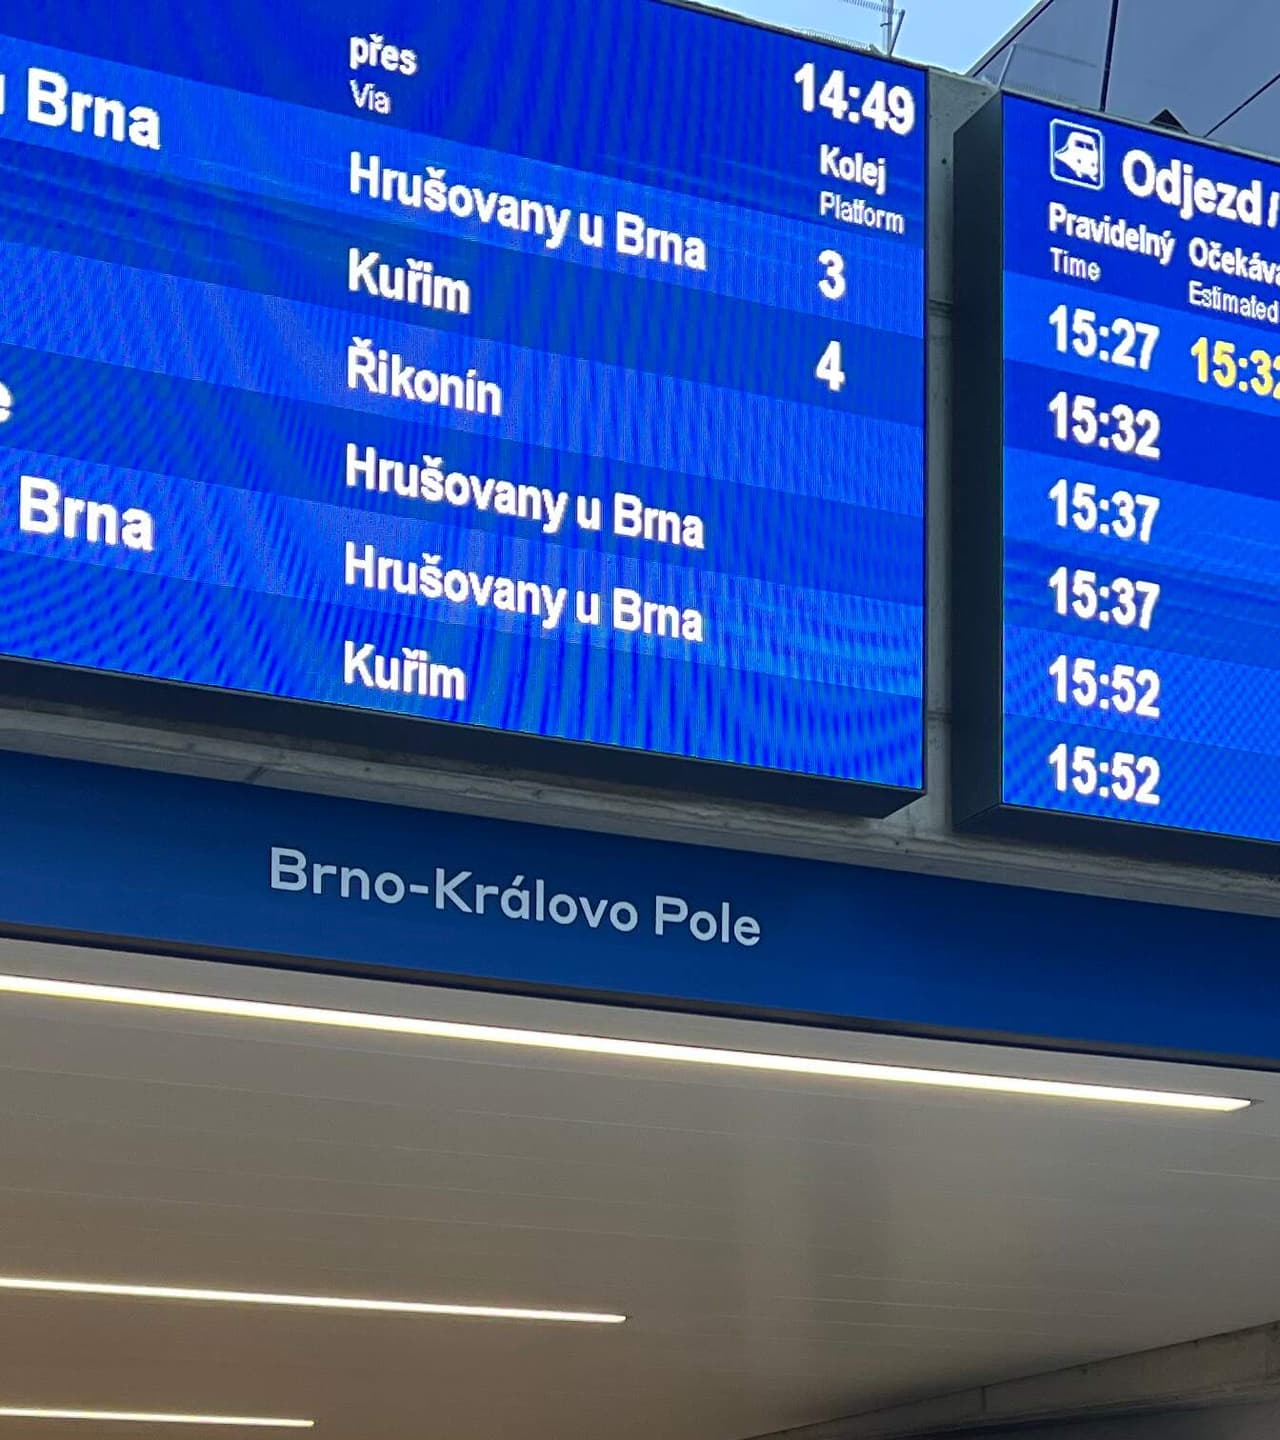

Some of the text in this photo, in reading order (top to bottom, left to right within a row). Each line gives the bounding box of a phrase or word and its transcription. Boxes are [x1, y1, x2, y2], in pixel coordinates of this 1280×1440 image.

[349, 33, 417, 76] přes
[27, 67, 161, 150] Brna
[793, 61, 916, 136] 14:49
[820, 144, 887, 194] Kolej
[1121, 148, 1263, 227] Odjezd
[349, 151, 707, 271] Hrušovany u Brna
[820, 190, 905, 234] Platform
[1049, 202, 1177, 267] Pravidelný
[348, 247, 470, 314] Kuřim
[818, 249, 846, 300] 3
[1050, 247, 1101, 281] Time
[1189, 280, 1280, 324] Estimated
[815, 340, 846, 391] 4
[1049, 304, 1160, 370] 15:27
[347, 336, 502, 416] Řikonín
[1048, 391, 1160, 459] 15:32
[19, 475, 154, 552] Brna
[346, 443, 705, 549] Hrušovany u Brna
[1049, 479, 1160, 543] 15:37
[345, 541, 704, 642] Hrušovany u Brna
[1049, 566, 1161, 630] 15:37
[344, 640, 466, 701] Kuřim
[1048, 654, 1160, 719] 15:52
[1048, 743, 1160, 805] 15:52
[269, 845, 762, 947] Brno-Královo Pole
